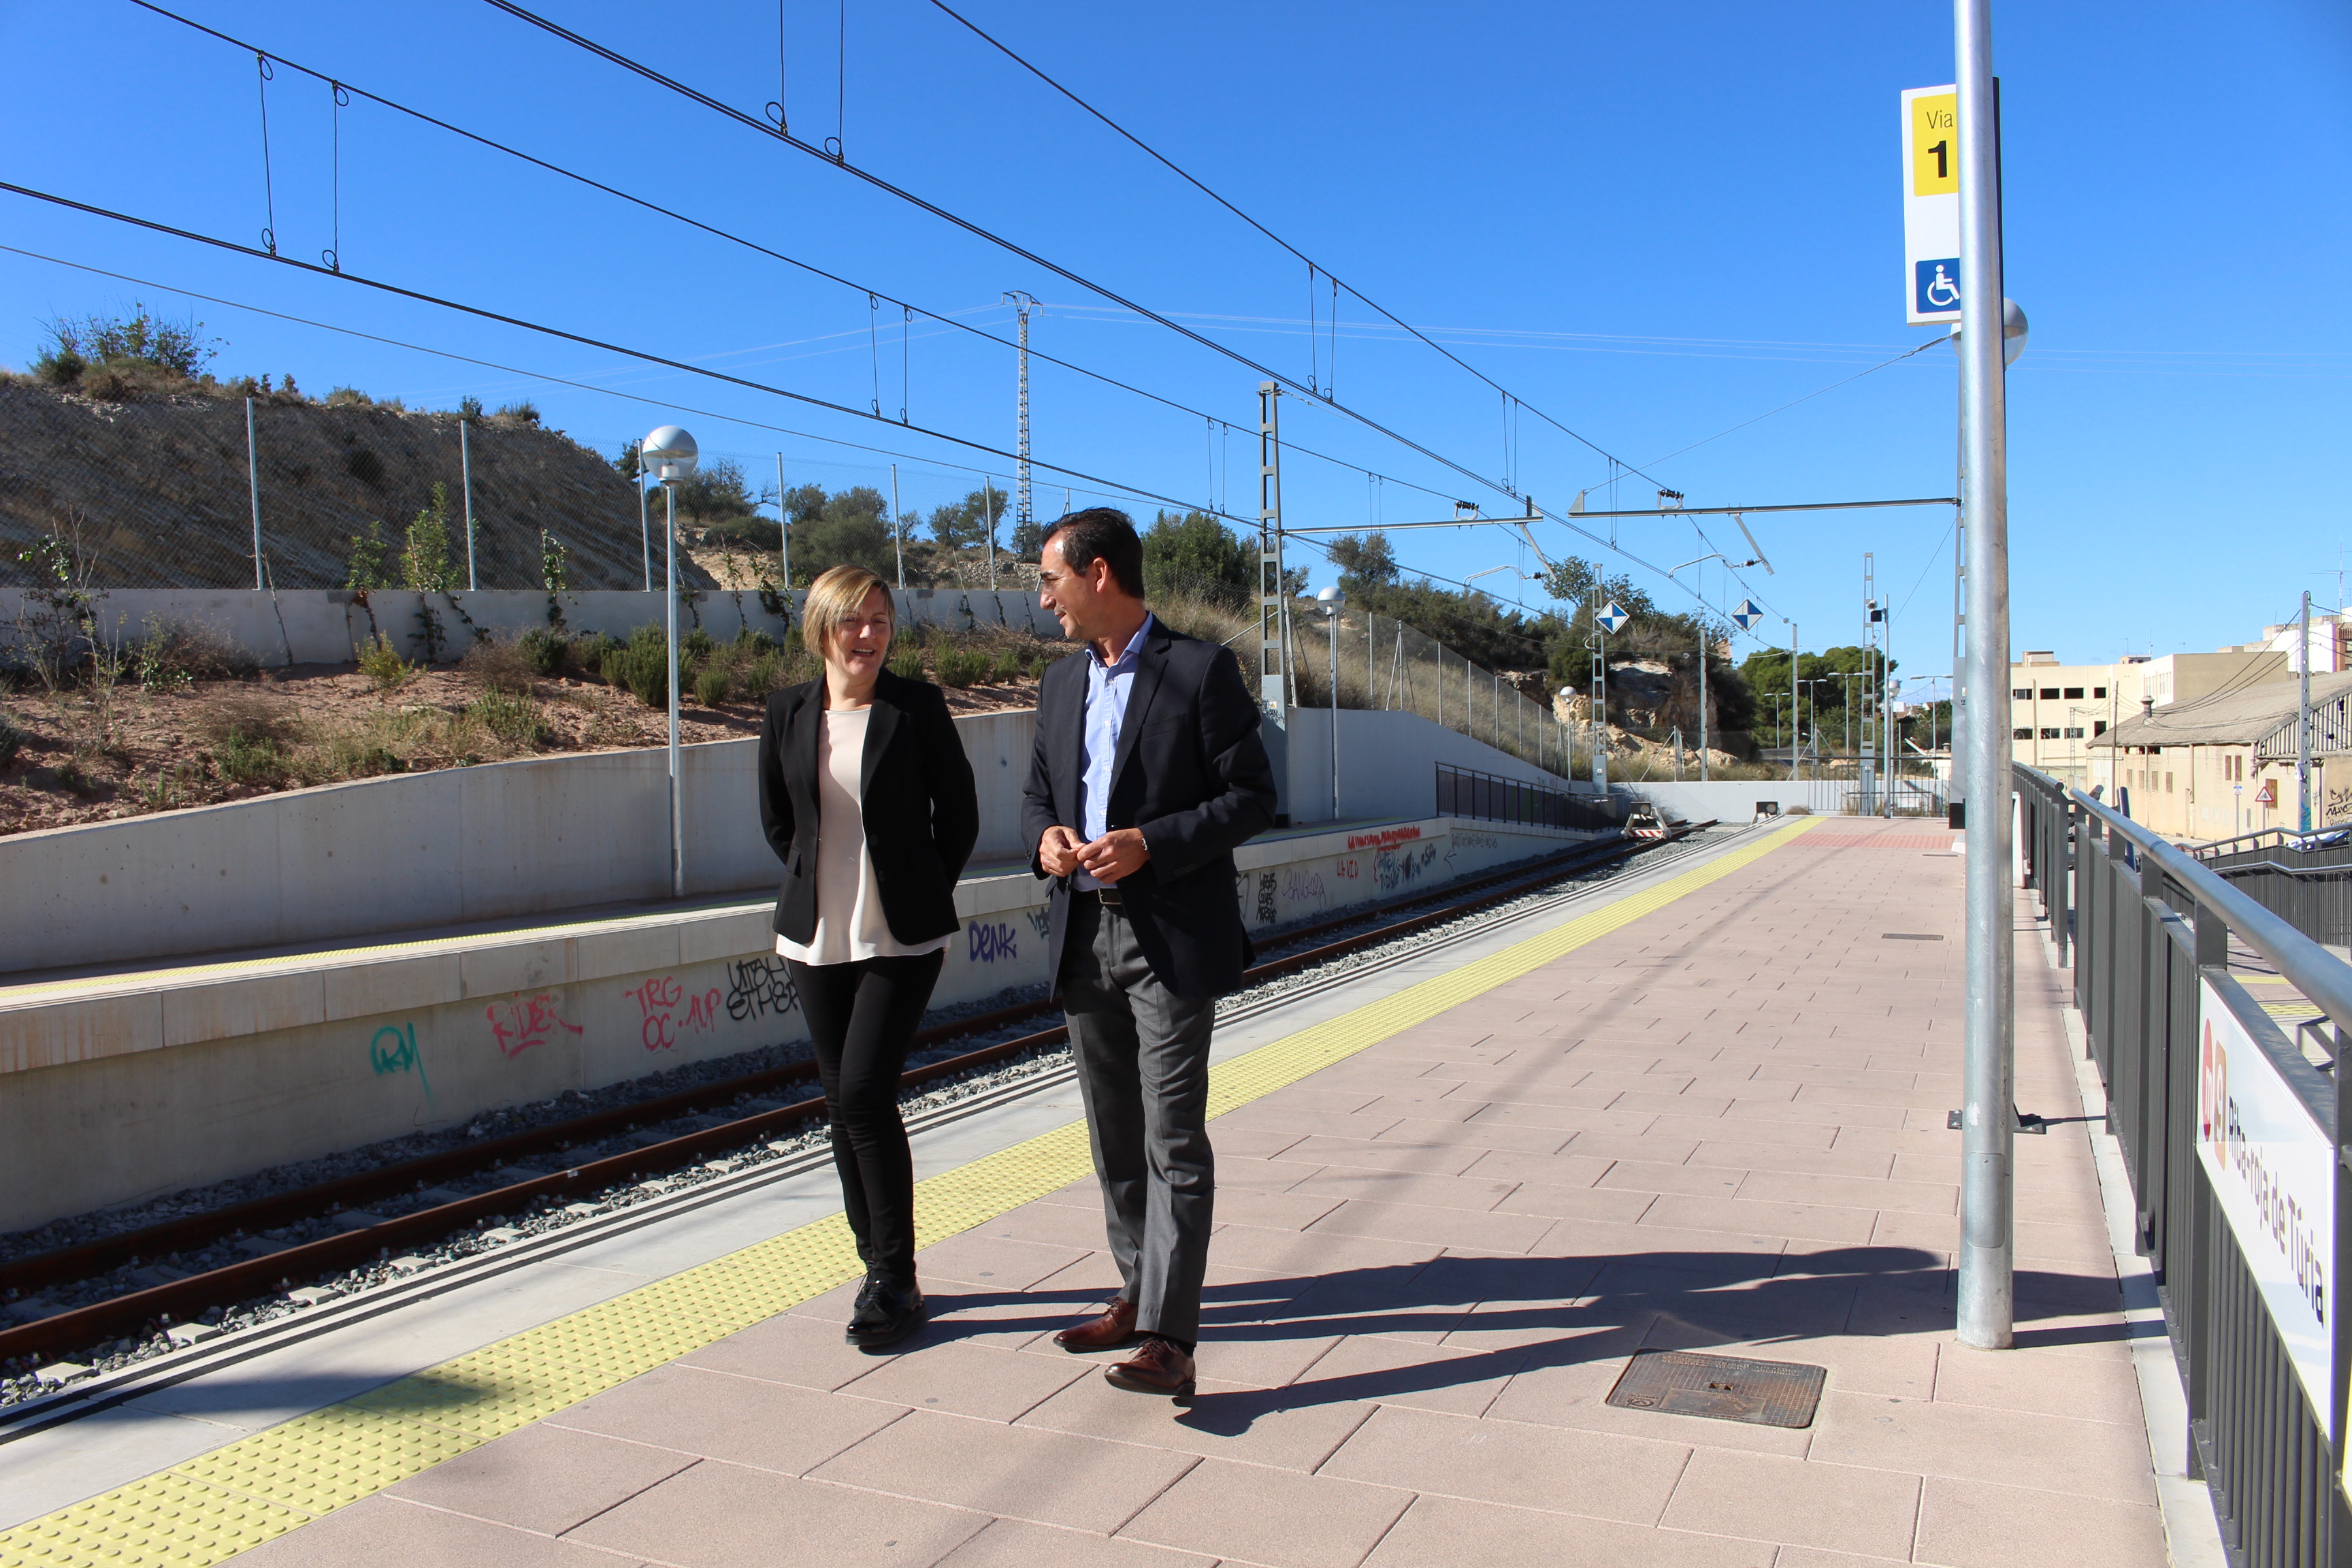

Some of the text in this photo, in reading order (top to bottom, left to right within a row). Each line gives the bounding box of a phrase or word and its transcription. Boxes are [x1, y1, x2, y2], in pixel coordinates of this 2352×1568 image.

[1926, 110, 1953, 129] Via
[1927, 140, 1947, 178] 1
[2217, 1064, 2223, 1144] 9
[2229, 1094, 2324, 1330] Riba-roja de Túria
